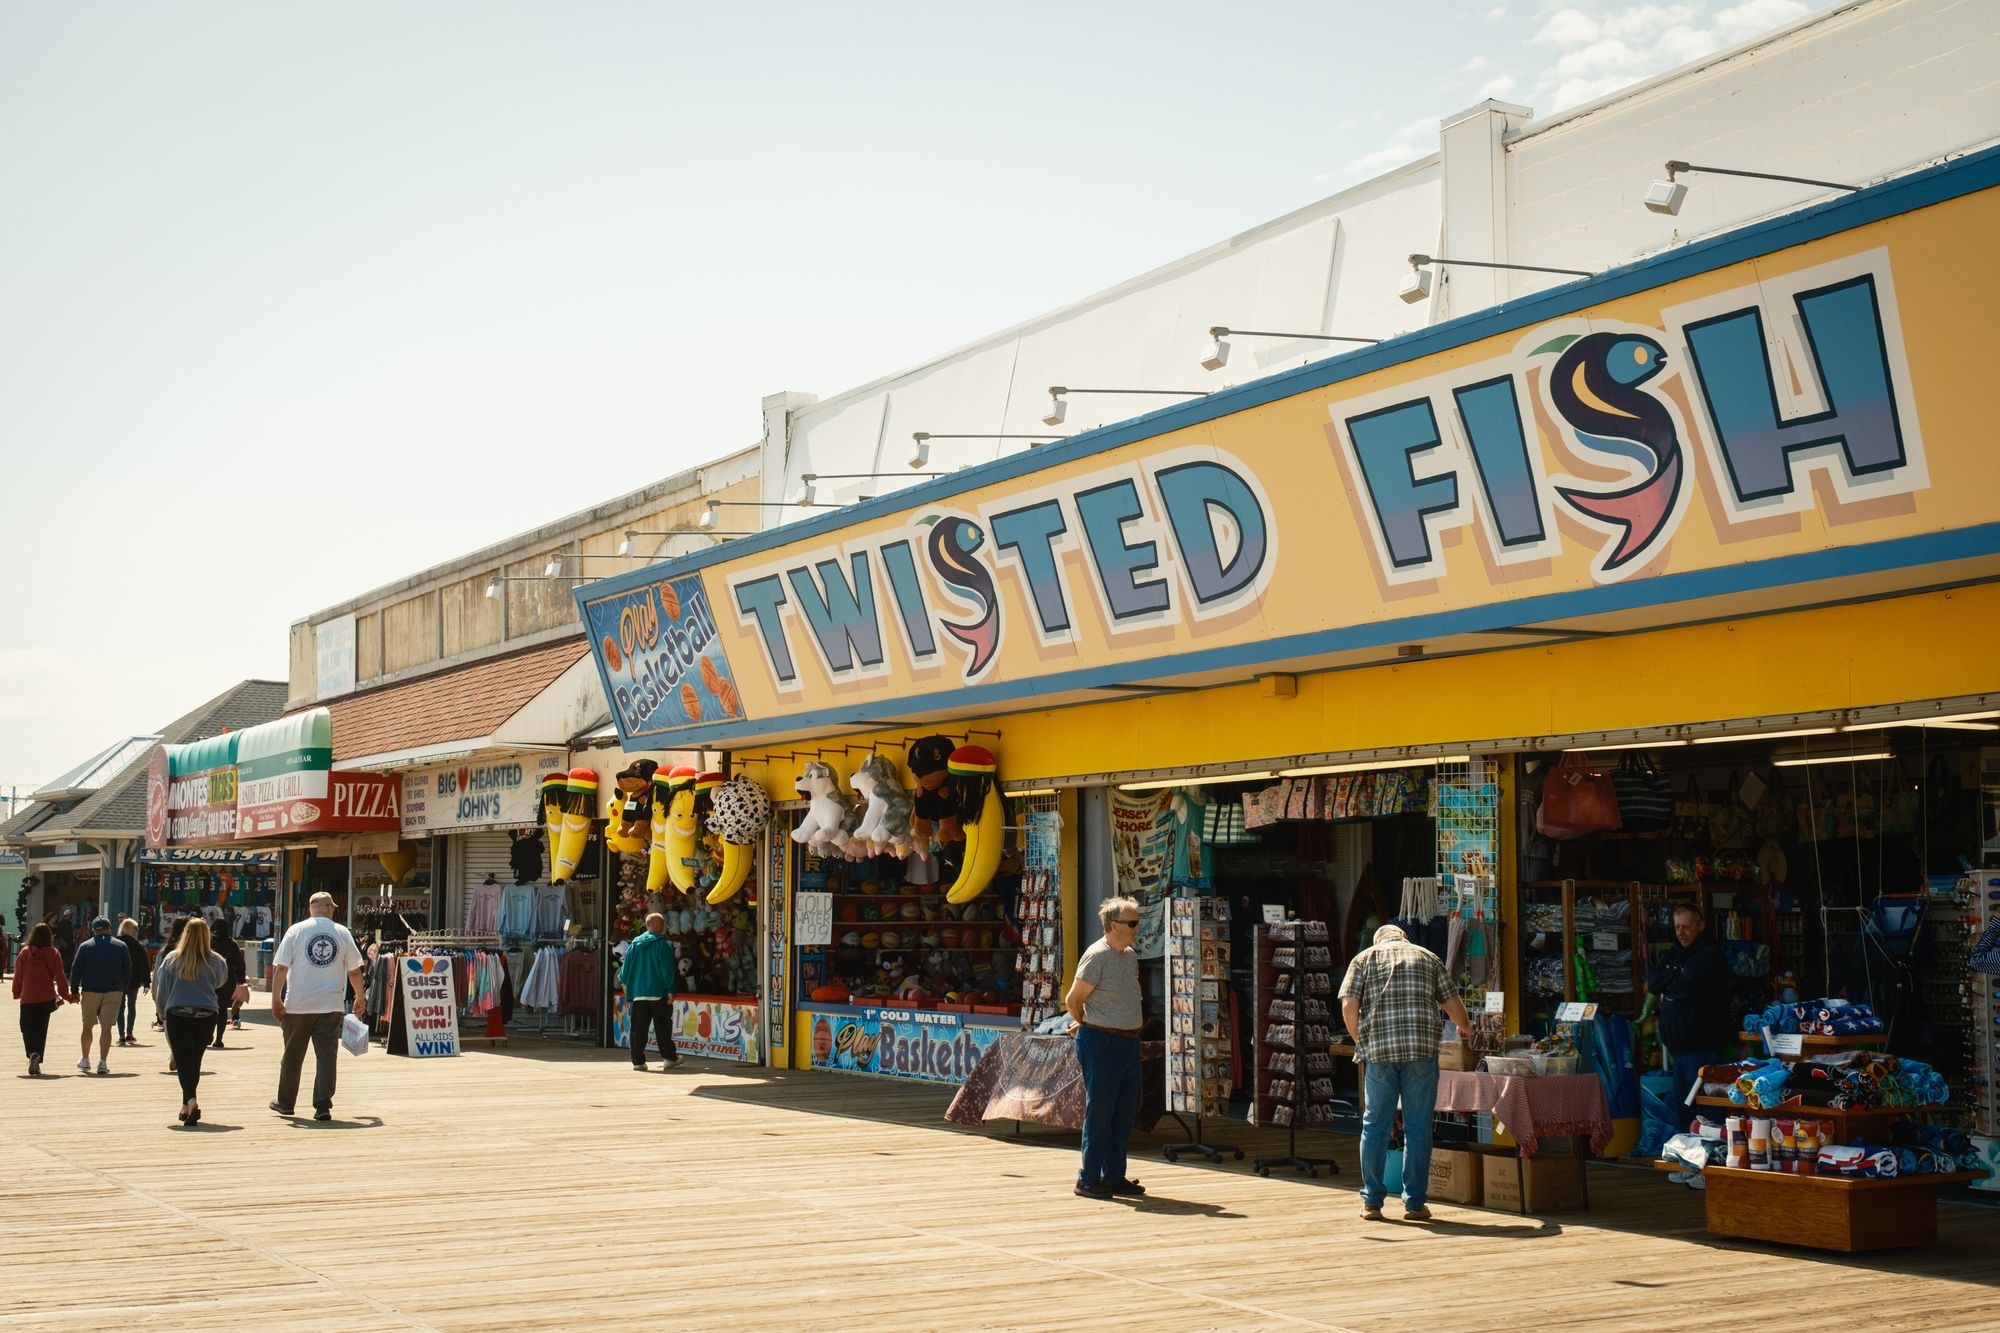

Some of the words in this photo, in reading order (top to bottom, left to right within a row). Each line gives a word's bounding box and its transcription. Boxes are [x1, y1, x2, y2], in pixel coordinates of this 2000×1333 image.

[731, 455, 1271, 681] TWISTED
[1343, 270, 1910, 575] FISH
[620, 586, 659, 683] Play
[615, 591, 717, 733] Basketball
[438, 772, 457, 796] BIG
[469, 762, 522, 793] HEARTED
[258, 780, 274, 803] PIZZA
[283, 775, 303, 797] GRILL
[332, 783, 400, 818] PIZZA
[457, 795, 500, 821] JOHN'S
[172, 849, 254, 861] SPORTS
[796, 895, 832, 913] COLD
[795, 911, 831, 925] WATER
[407, 976, 449, 986] BUST
[411, 989, 449, 999] ONE
[879, 1010, 910, 1022] COLD
[915, 1012, 956, 1025] WATER
[415, 1033, 430, 1041] ALL
[433, 1032, 453, 1041] KIDS
[833, 1023, 881, 1068] Play
[416, 1041, 454, 1055] WIN!
[709, 1044, 741, 1055] TIME
